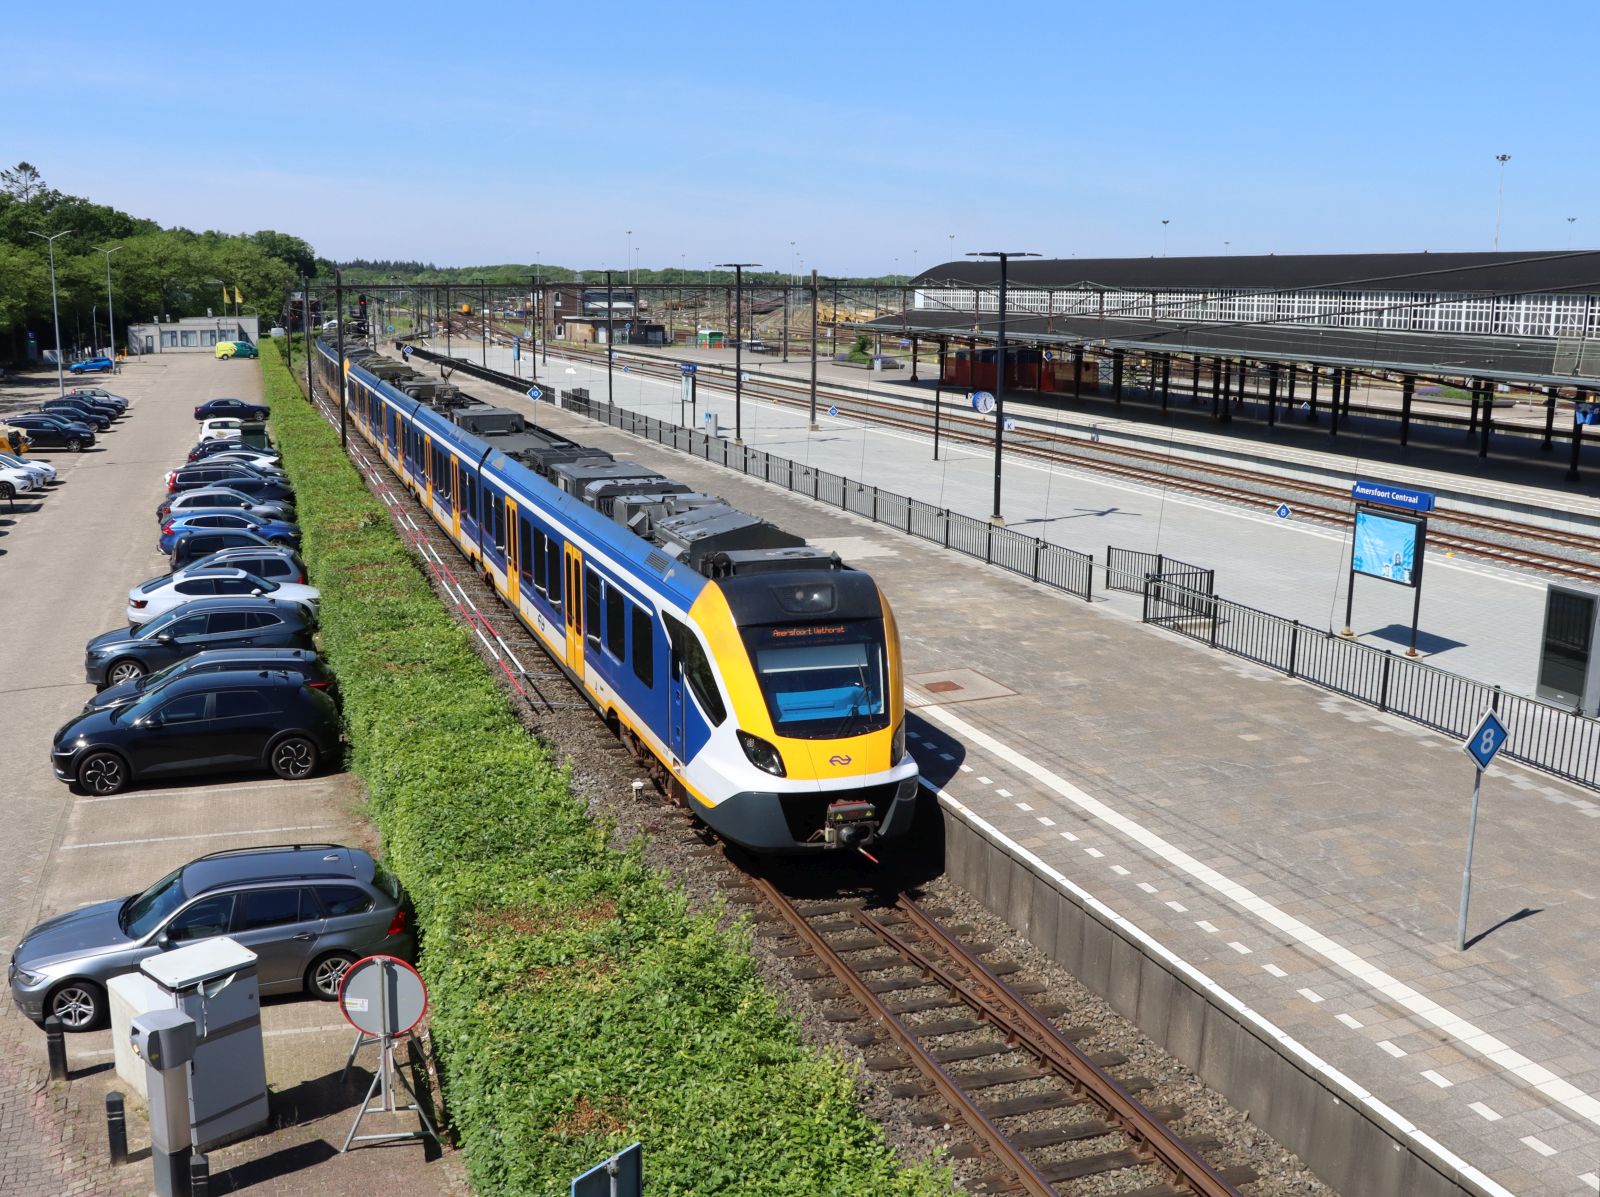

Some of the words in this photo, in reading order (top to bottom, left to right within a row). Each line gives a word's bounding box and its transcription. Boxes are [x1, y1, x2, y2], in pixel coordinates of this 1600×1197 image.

[1356, 486, 1390, 498] Amersfoort
[1391, 492, 1419, 504] Centraal
[544, 533, 549, 552] 2
[1480, 728, 1495, 754] 8
